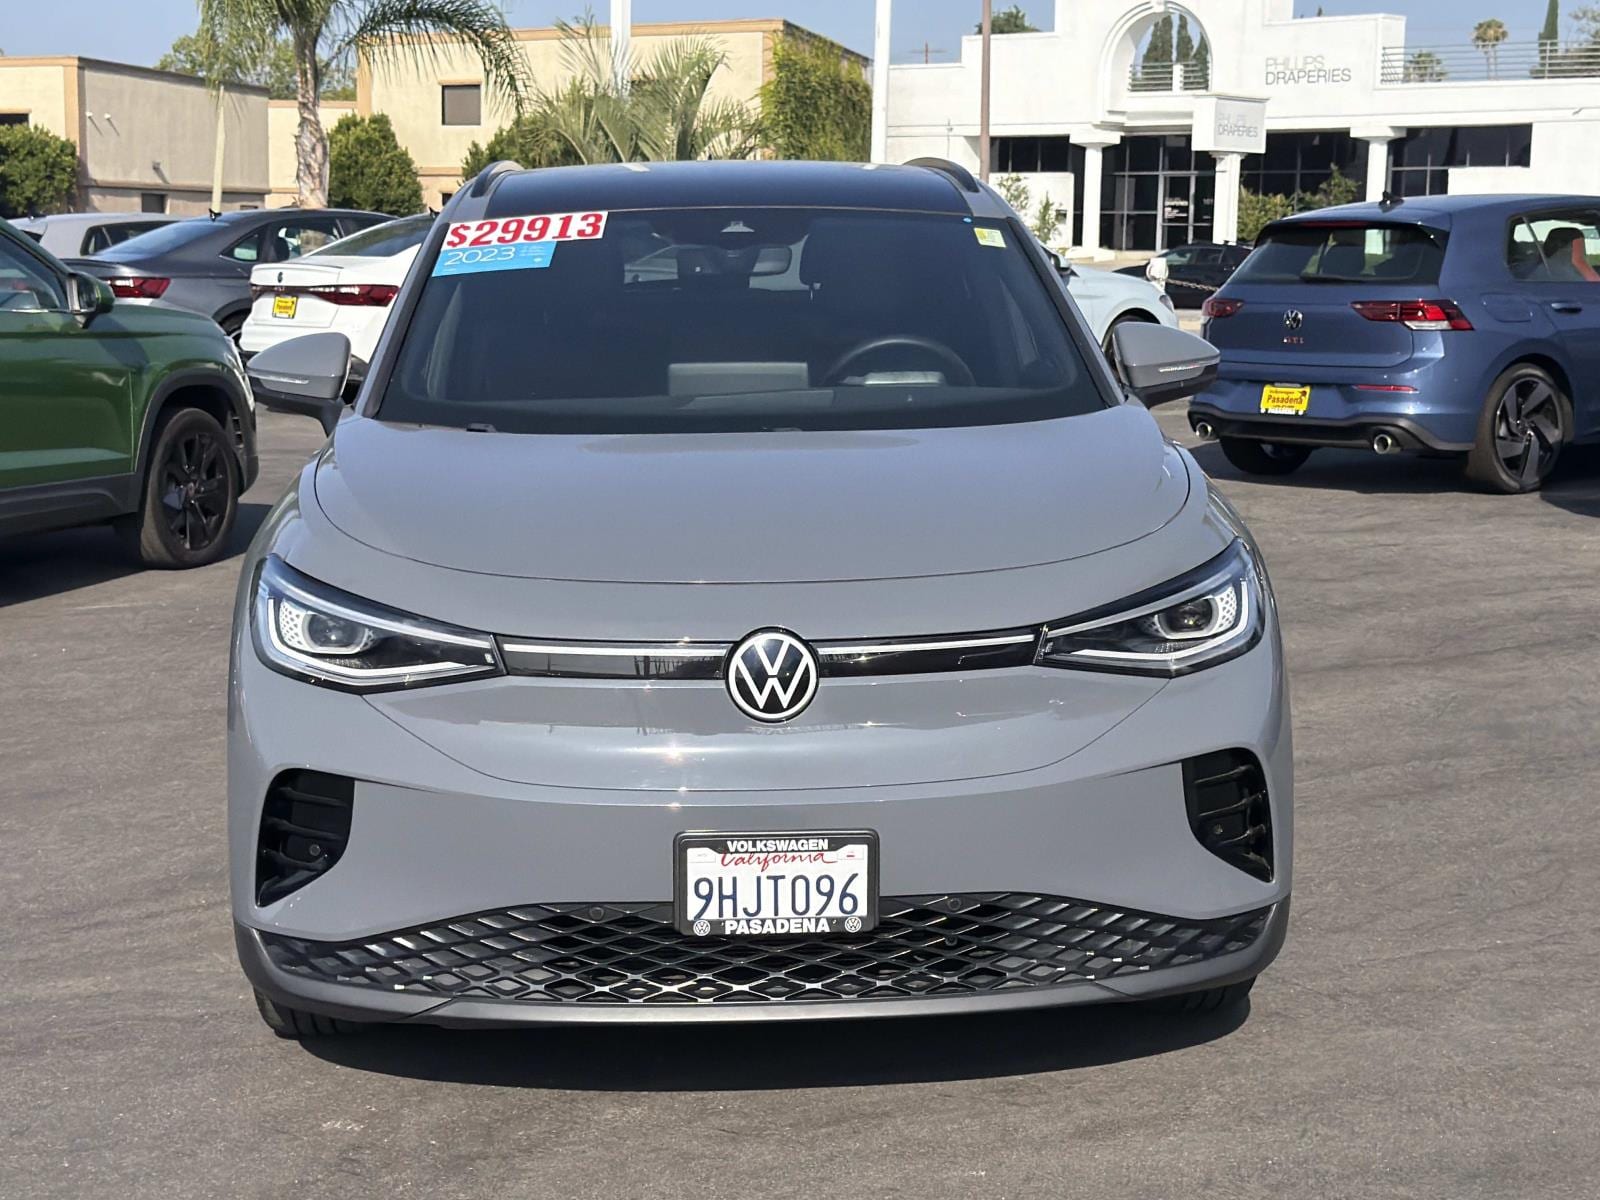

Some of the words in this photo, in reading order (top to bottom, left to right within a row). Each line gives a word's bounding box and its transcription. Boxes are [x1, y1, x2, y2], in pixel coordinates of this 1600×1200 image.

[1265, 55, 1325, 70] PHILLIPS
[1265, 68, 1352, 86] DRAPERIES
[1217, 123, 1259, 138] DRAPERIES
[446, 213, 603, 248] $29913
[443, 247, 516, 266] 2023
[1267, 394, 1303, 405] Pasadena
[726, 838, 829, 853] VOLKSWAGEN
[720, 851, 838, 873] California
[693, 873, 859, 921] 9HJT096
[724, 917, 831, 934] PASADENA
